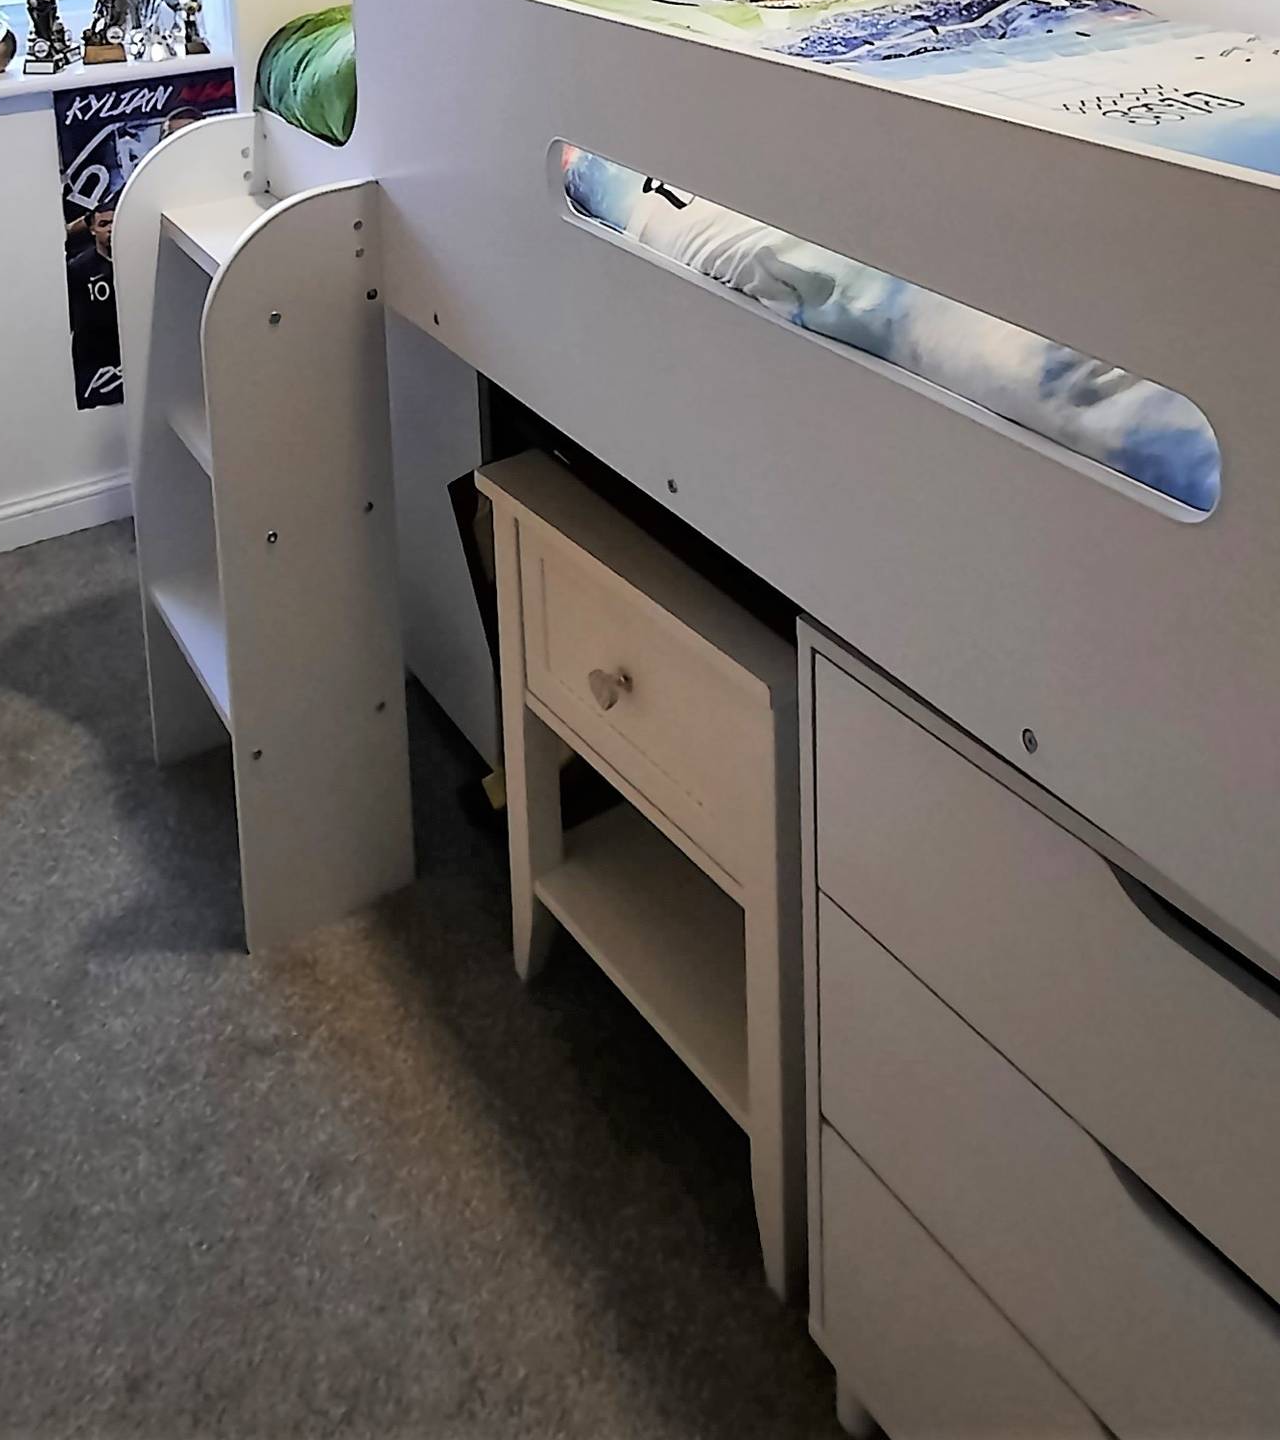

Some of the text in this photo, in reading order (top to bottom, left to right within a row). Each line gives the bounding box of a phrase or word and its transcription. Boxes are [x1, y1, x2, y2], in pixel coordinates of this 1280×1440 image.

[65, 85, 173, 126] KYLIAN
[86, 280, 110, 302] 10
[84, 364, 125, 398] PS
